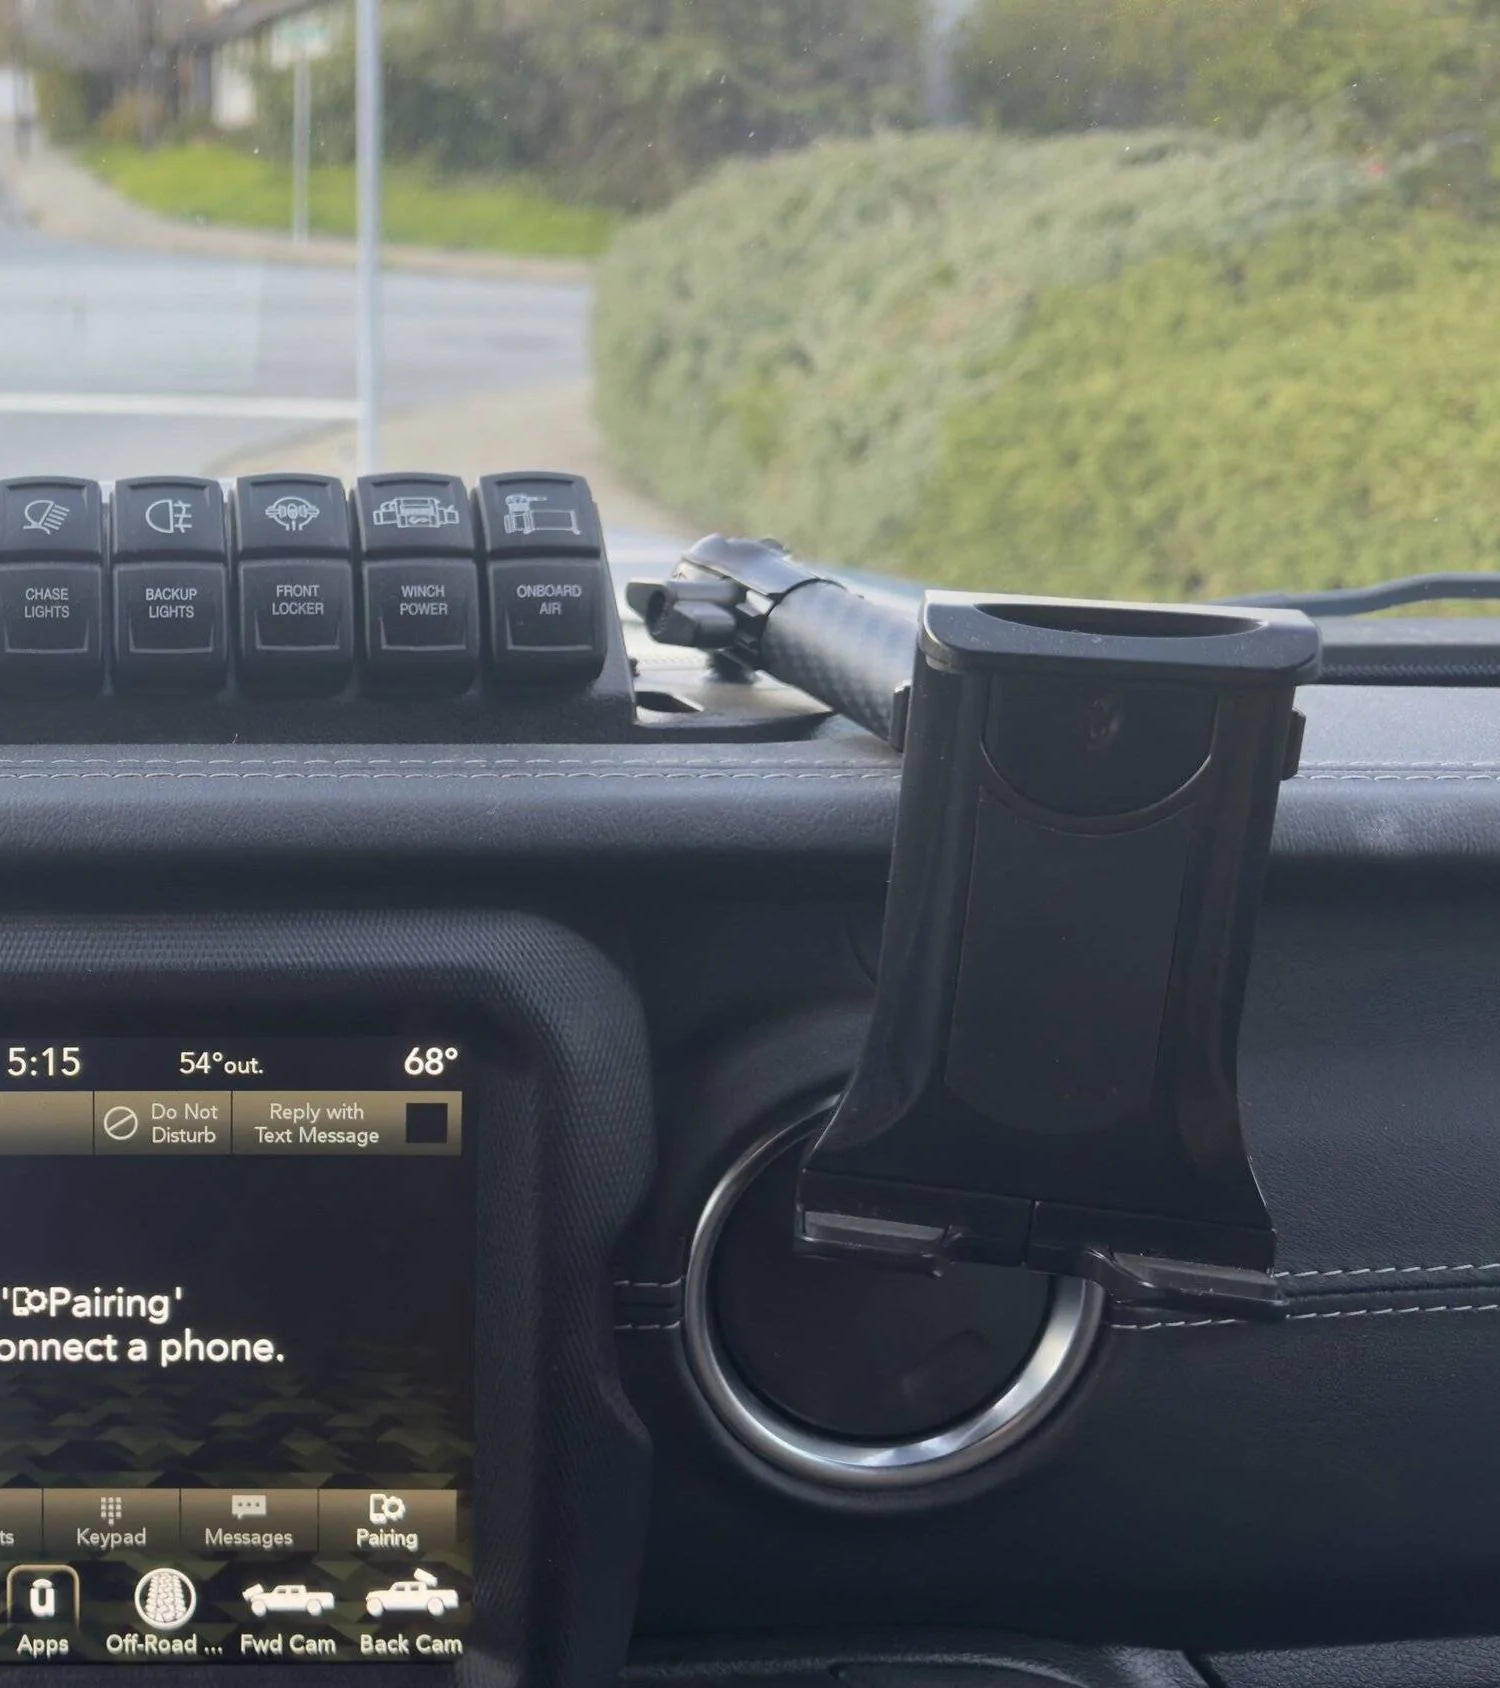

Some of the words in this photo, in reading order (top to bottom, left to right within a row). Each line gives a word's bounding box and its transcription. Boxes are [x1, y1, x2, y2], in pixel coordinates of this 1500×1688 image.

[25, 587, 69, 601] CHASE
[145, 587, 197, 601] BACKUP
[276, 584, 319, 598] FRONT
[401, 584, 445, 598] WINCH
[516, 584, 582, 598] ONBOARD
[24, 605, 70, 619] LIGHTS
[148, 605, 195, 619] LIGHTS
[272, 602, 324, 616] LOCKER
[400, 602, 448, 616] POWER
[539, 602, 562, 616] AIR
[7, 1046, 81, 1077] 5:15
[404, 1046, 459, 1076] 68°
[151, 1103, 177, 1120] Do
[185, 1103, 218, 1120] Not
[269, 1103, 320, 1123] Reply
[326, 1103, 364, 1120] with
[152, 1126, 216, 1144] Disturb
[254, 1127, 294, 1144] Text
[299, 1127, 380, 1148] Message
[127, 1337, 148, 1362] a
[160, 1328, 284, 1368] phone.
[76, 1528, 147, 1549] Keypad
[205, 1528, 293, 1549] Messages
[356, 1528, 419, 1551] Pairing
[17, 1634, 69, 1659] Apps
[106, 1633, 198, 1656] Off-Road
[240, 1634, 282, 1655] Fwd
[288, 1634, 336, 1656] Cam
[360, 1634, 409, 1655] Back
[412, 1634, 463, 1656] Cam
